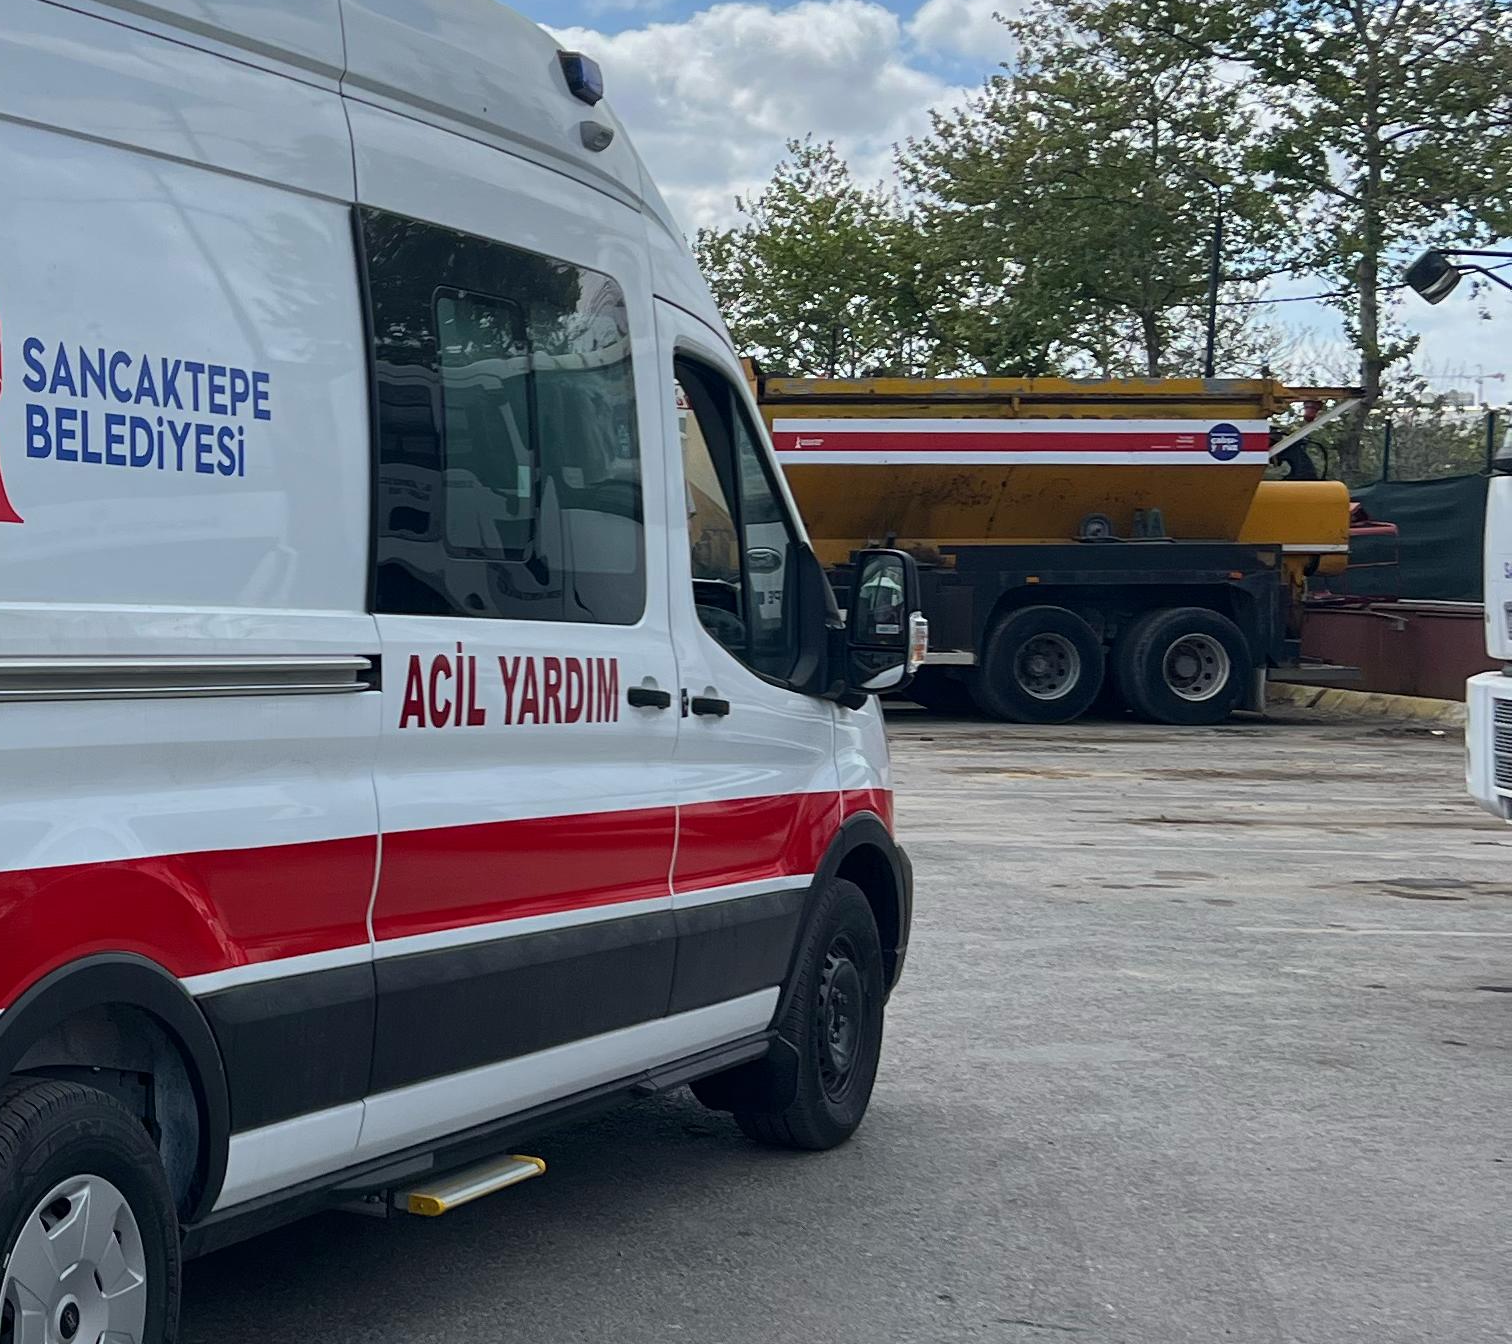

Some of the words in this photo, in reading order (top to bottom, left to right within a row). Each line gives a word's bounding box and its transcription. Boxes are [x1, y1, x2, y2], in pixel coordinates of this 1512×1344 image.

[22, 336, 272, 421] SANCAKTEPE
[398, 641, 486, 728] ACİL
[498, 656, 619, 725] YARDIM
